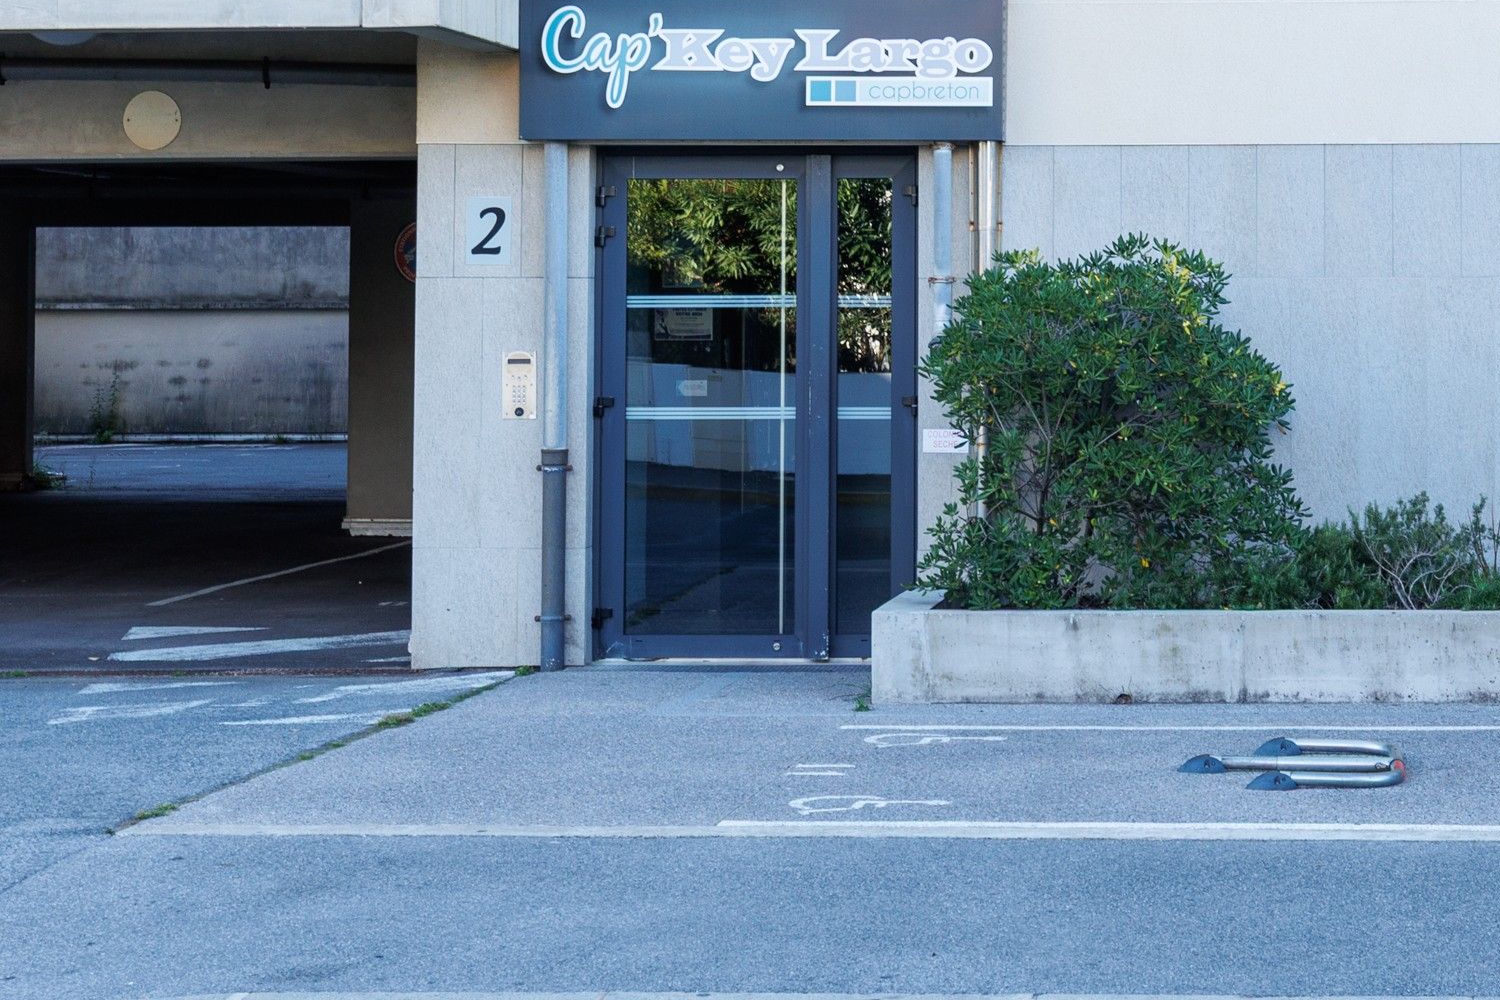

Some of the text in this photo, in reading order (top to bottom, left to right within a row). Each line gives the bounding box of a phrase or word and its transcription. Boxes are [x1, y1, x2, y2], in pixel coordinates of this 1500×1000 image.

[794, 29, 993, 78] Largo
[869, 81, 979, 102] capbreton
[471, 206, 505, 255] 2
[928, 430, 960, 438] COLON
